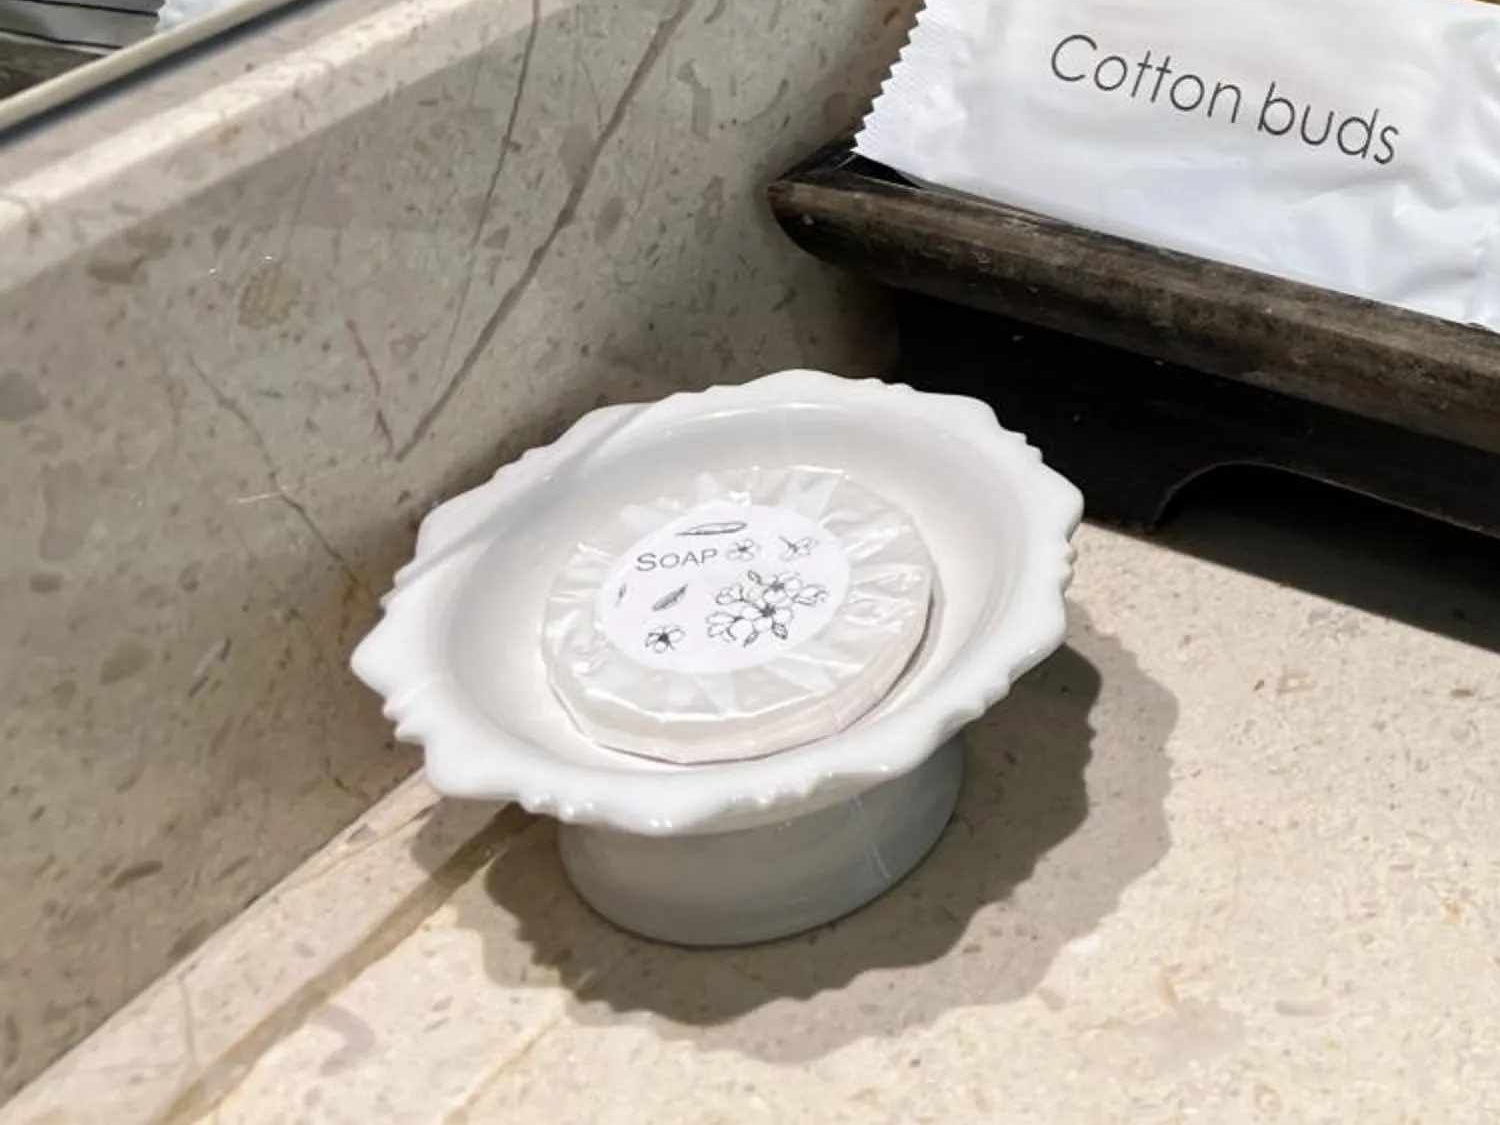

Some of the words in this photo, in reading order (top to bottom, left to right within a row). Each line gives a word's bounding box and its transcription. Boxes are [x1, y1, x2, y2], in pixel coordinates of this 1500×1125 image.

[1051, 34, 1242, 123] Cotton
[1257, 81, 1400, 165] buds
[635, 548, 718, 572] SOAP
